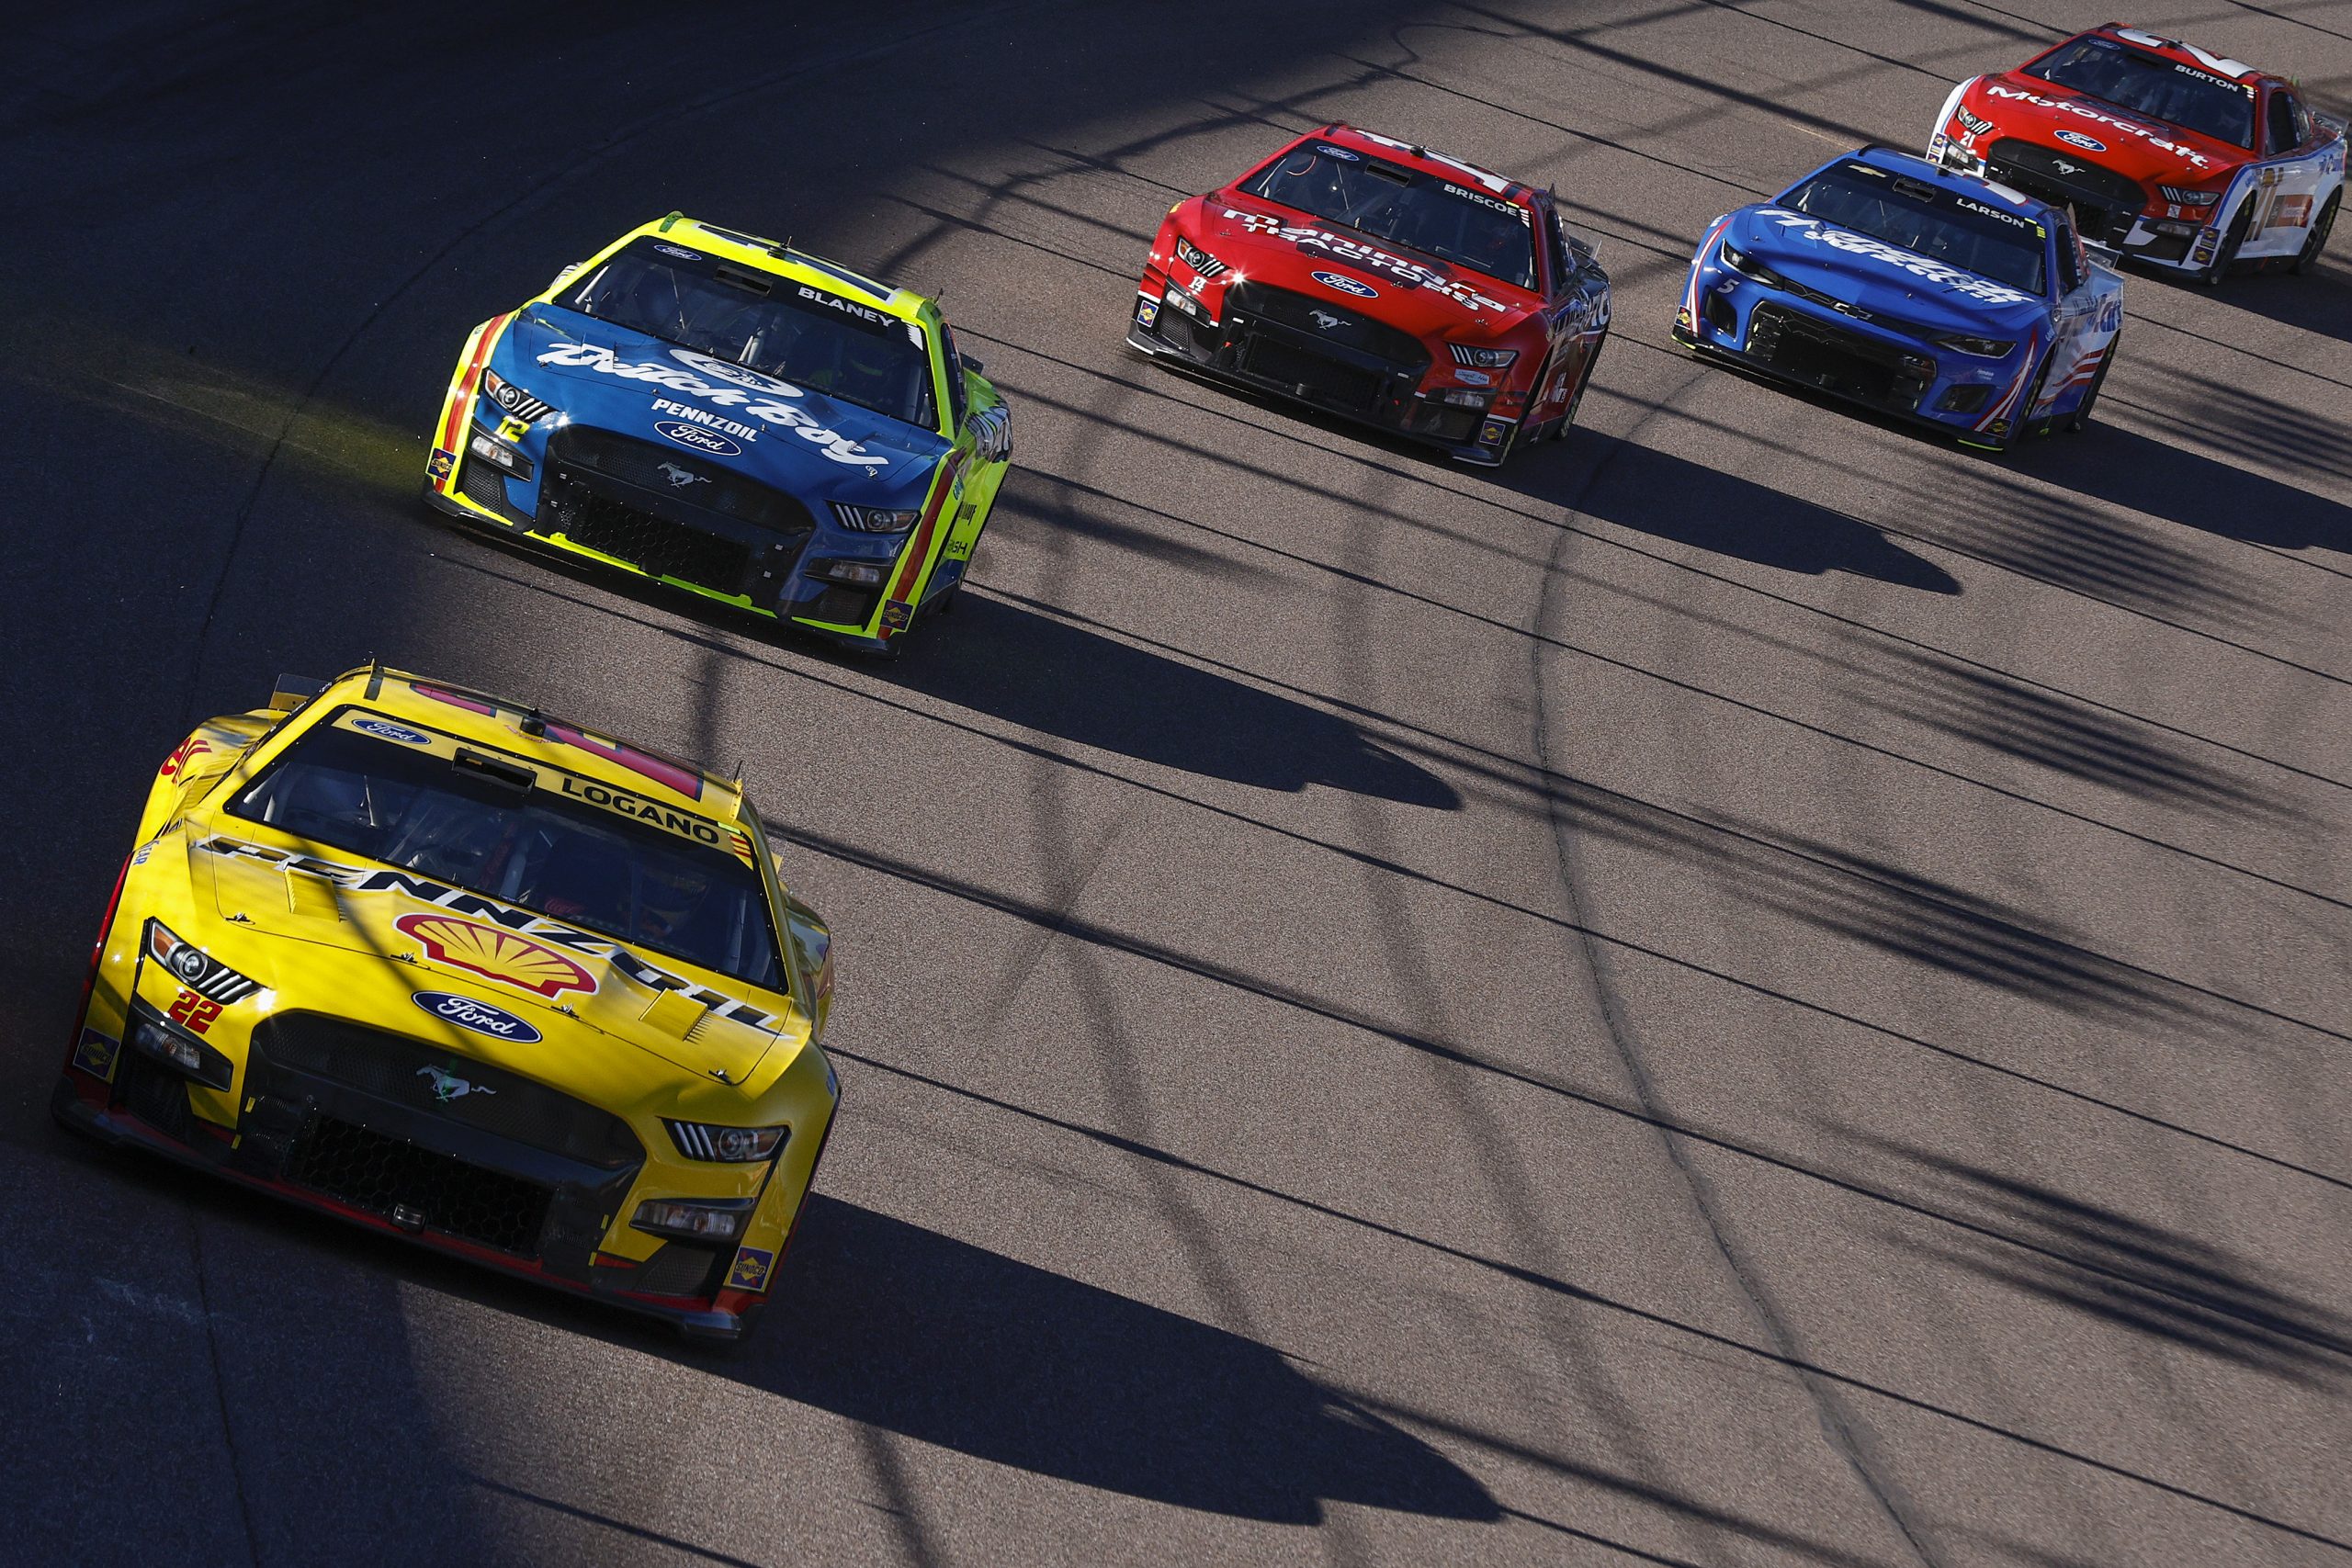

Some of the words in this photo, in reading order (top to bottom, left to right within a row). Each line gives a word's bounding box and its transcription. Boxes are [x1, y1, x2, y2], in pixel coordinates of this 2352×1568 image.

[2174, 64, 2238, 92] BURTON
[1960, 130, 1976, 147] 21
[1444, 184, 1517, 217] BRISCOE
[1956, 198, 2025, 229] LARSON
[1189, 276, 1207, 292] 14
[1323, 273, 1366, 296] Ford
[1716, 278, 1739, 293] 5
[797, 287, 896, 328] BLANEY
[492, 416, 530, 443] 12
[651, 398, 759, 443] PENNZOIL
[745, 397, 889, 466] Boy
[670, 424, 725, 452] Ford
[366, 721, 416, 743] Ford
[561, 778, 719, 846] LOGANO
[191, 833, 794, 1039] PENNZOIL
[168, 990, 223, 1034] 22
[435, 995, 517, 1037] Ford
[82, 1043, 112, 1064] SUNOCO
[736, 1262, 764, 1277] SUNOCO
